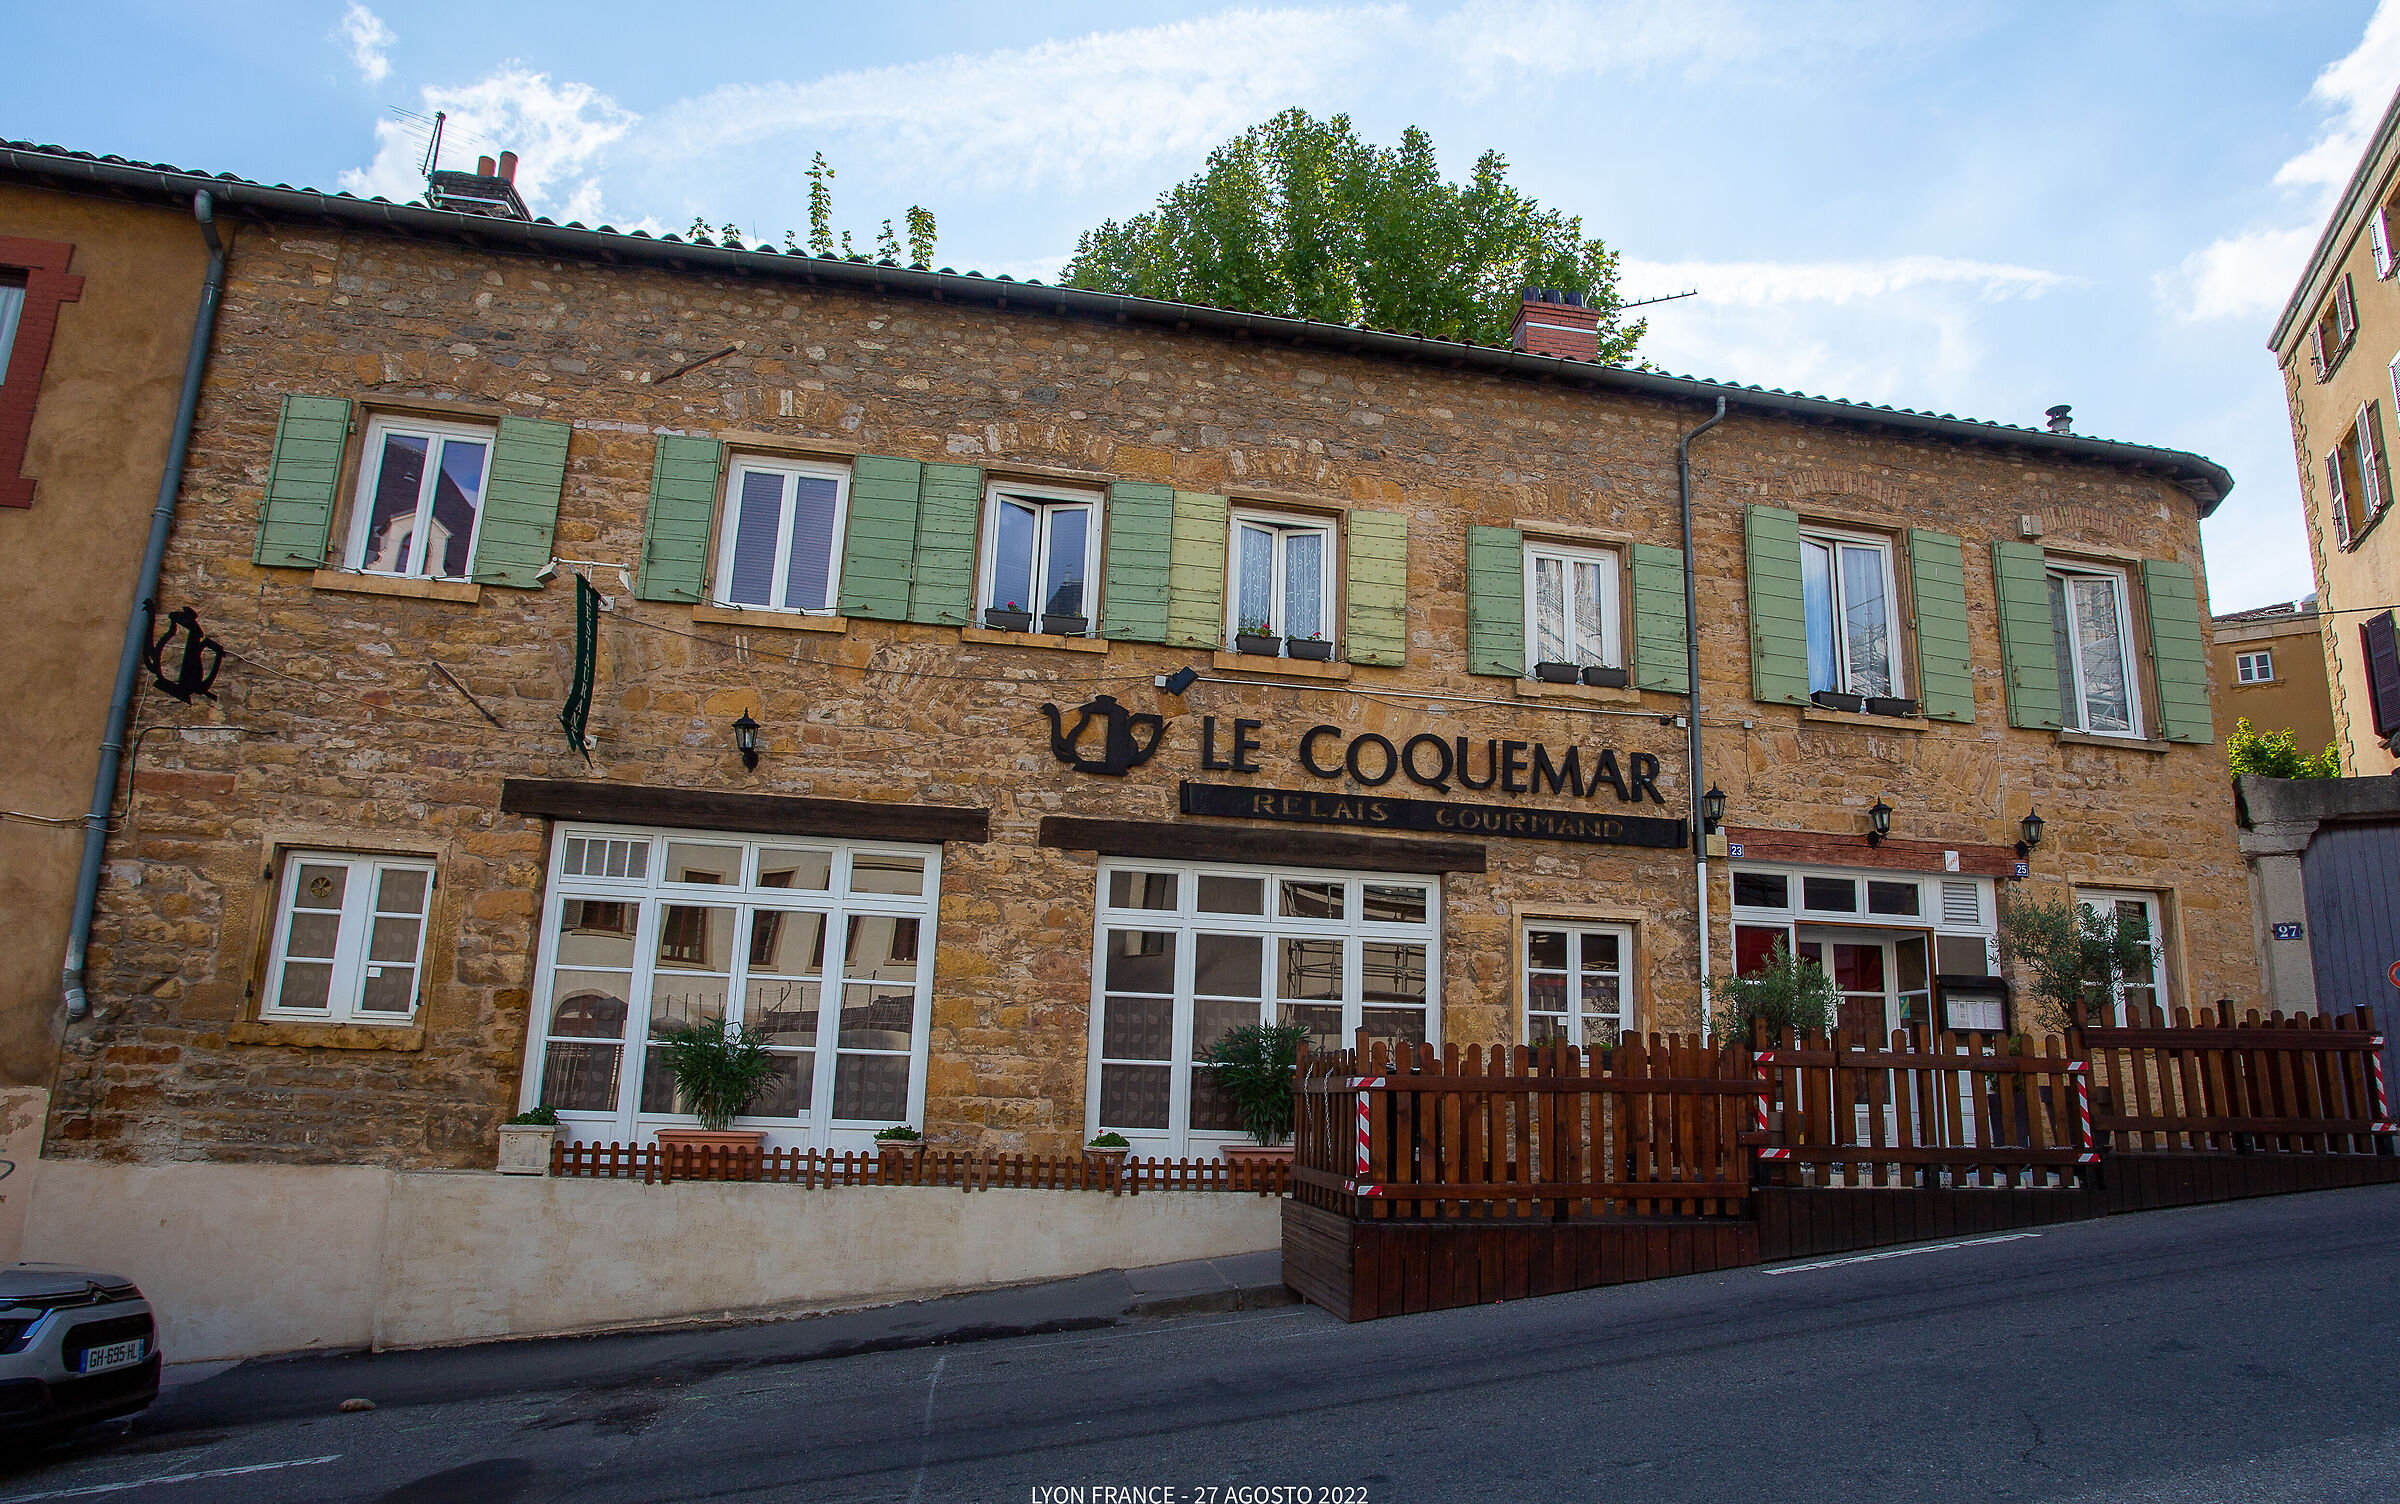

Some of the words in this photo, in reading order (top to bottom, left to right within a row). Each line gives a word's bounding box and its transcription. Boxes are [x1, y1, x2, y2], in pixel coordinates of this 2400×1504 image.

[1202, 715, 1262, 773] LE
[1300, 724, 1667, 804] COQUEMAR
[1253, 793, 1390, 822] RELAIS
[1435, 807, 1624, 839] GOURMAND
[1731, 845, 1743, 856] 23
[2016, 864, 2027, 874] 25
[2278, 925, 2298, 938] 27
[90, 1343, 138, 1368] GH-695-HL
